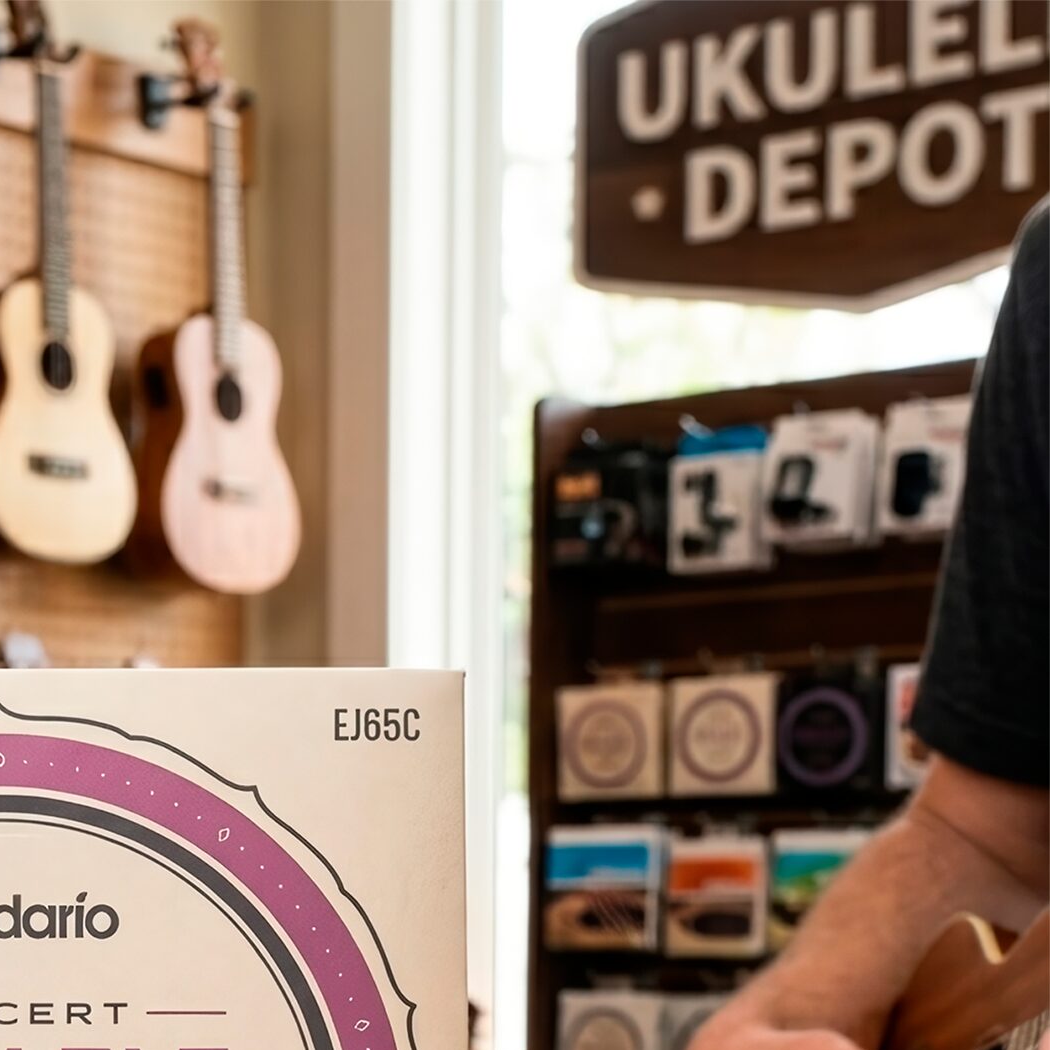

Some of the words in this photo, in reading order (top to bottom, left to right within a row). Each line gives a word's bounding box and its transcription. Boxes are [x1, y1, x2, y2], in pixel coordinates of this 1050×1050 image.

[615, 0, 1050, 143] UKULEL
[683, 83, 1050, 245] DEPOT
[333, 707, 422, 743] EJ65C
